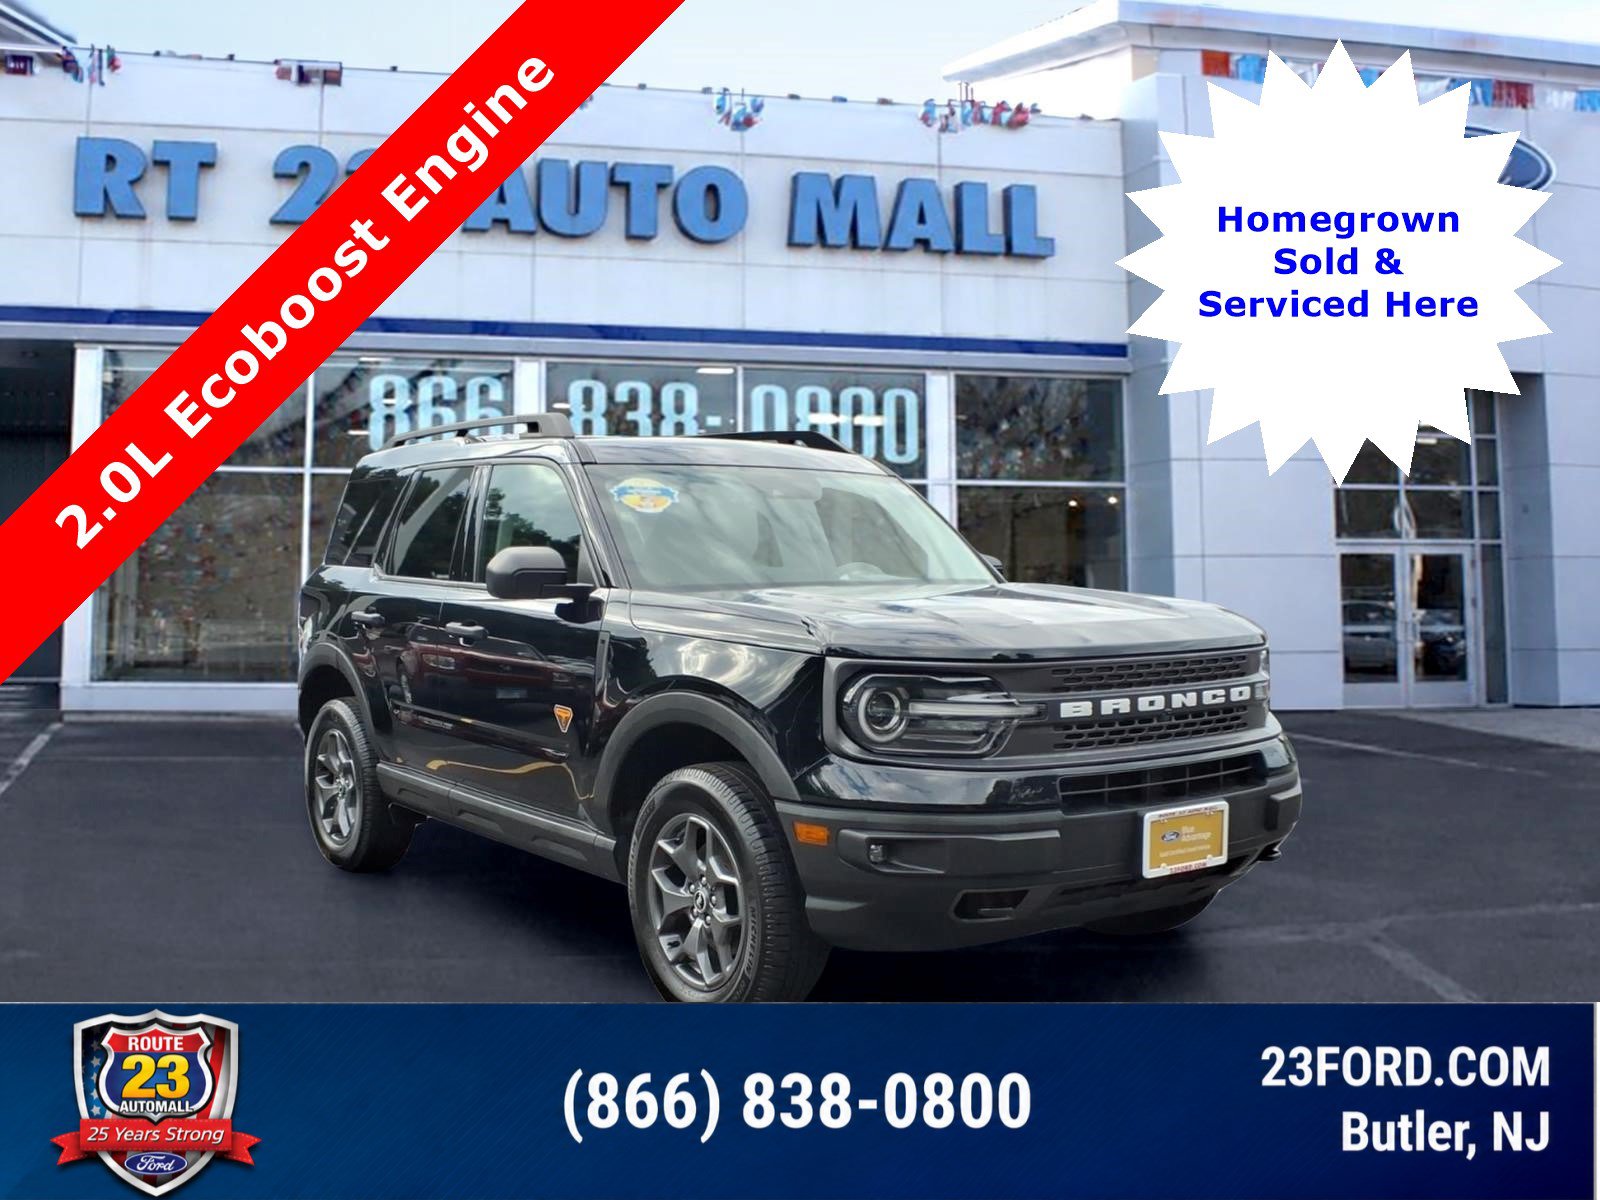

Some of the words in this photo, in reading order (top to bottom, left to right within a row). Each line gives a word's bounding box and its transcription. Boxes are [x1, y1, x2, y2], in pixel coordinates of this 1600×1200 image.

[74, 136, 217, 221] RT
[269, 144, 376, 225] 2
[462, 158, 749, 243] AUTO
[787, 171, 1055, 258] MALL
[369, 374, 503, 451] 866
[1059, 686, 1250, 718] BRONCO
